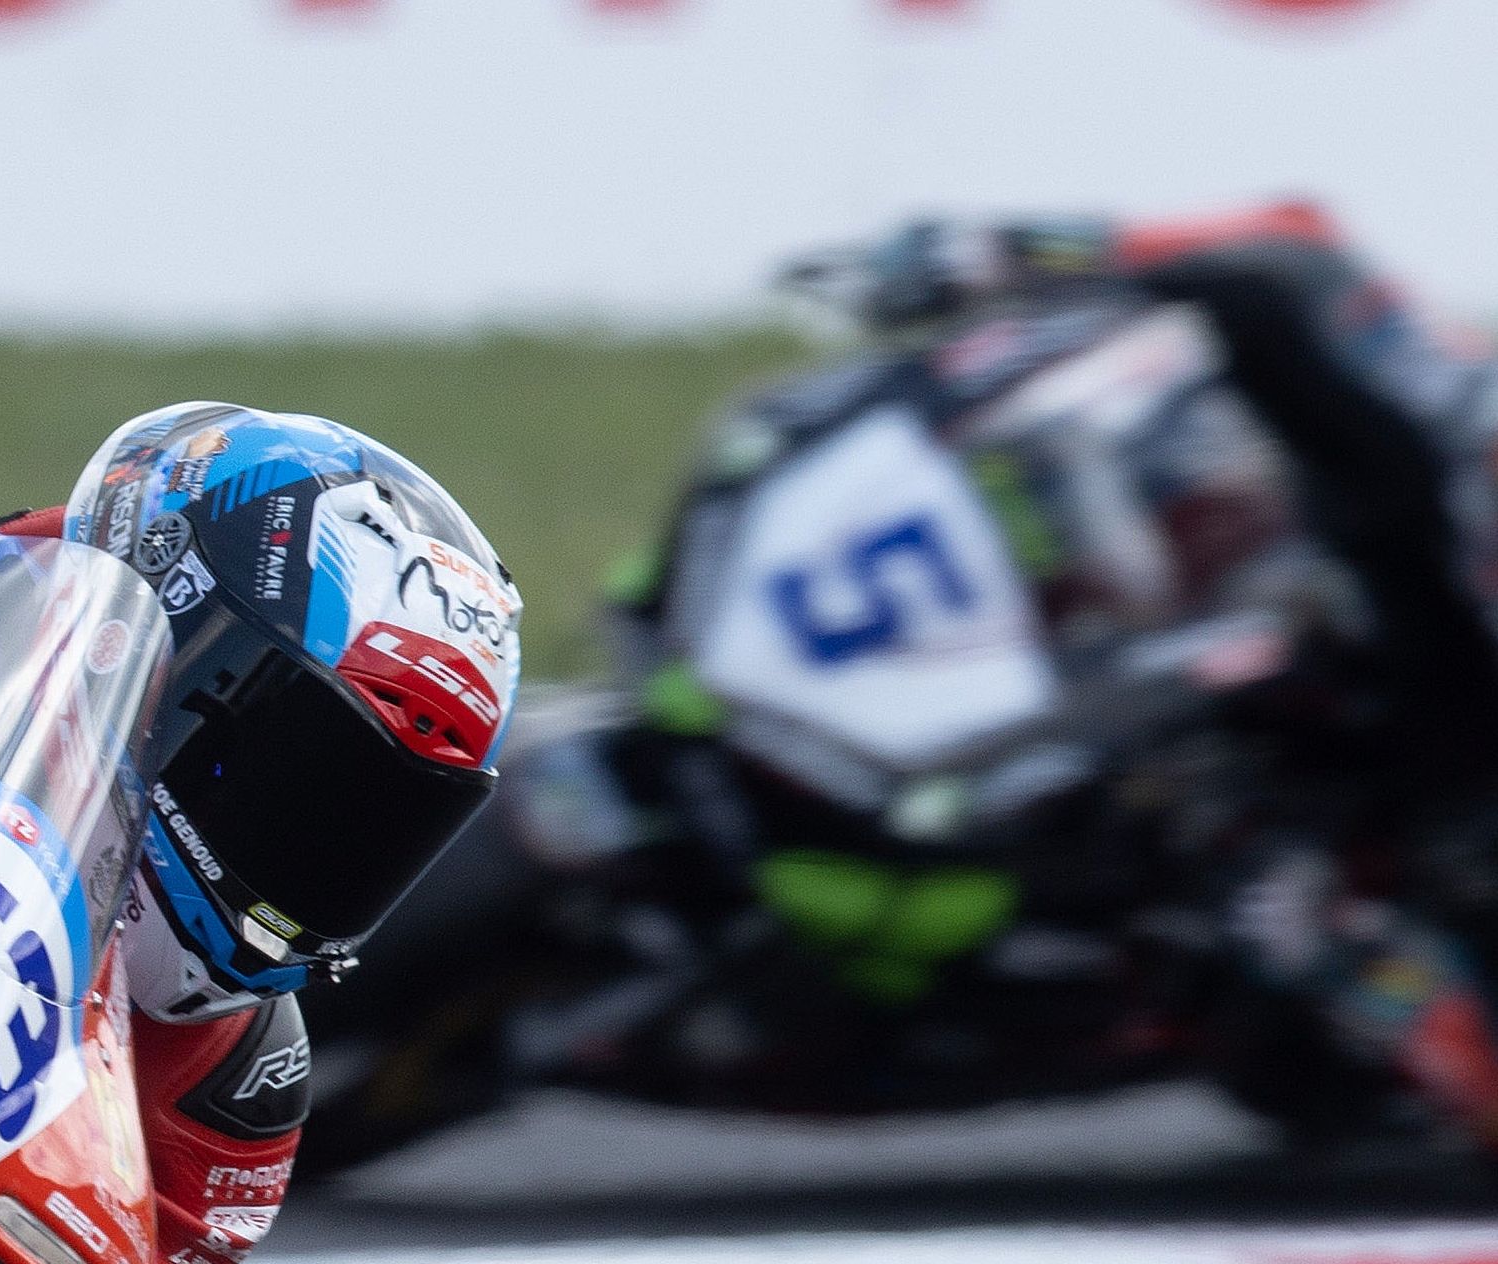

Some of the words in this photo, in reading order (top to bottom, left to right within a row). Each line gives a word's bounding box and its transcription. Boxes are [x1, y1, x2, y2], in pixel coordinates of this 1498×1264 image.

[274, 495, 296, 531] ERIC
[264, 546, 289, 601] FAVRE
[763, 508, 982, 668] 5
[365, 632, 500, 726] LS2
